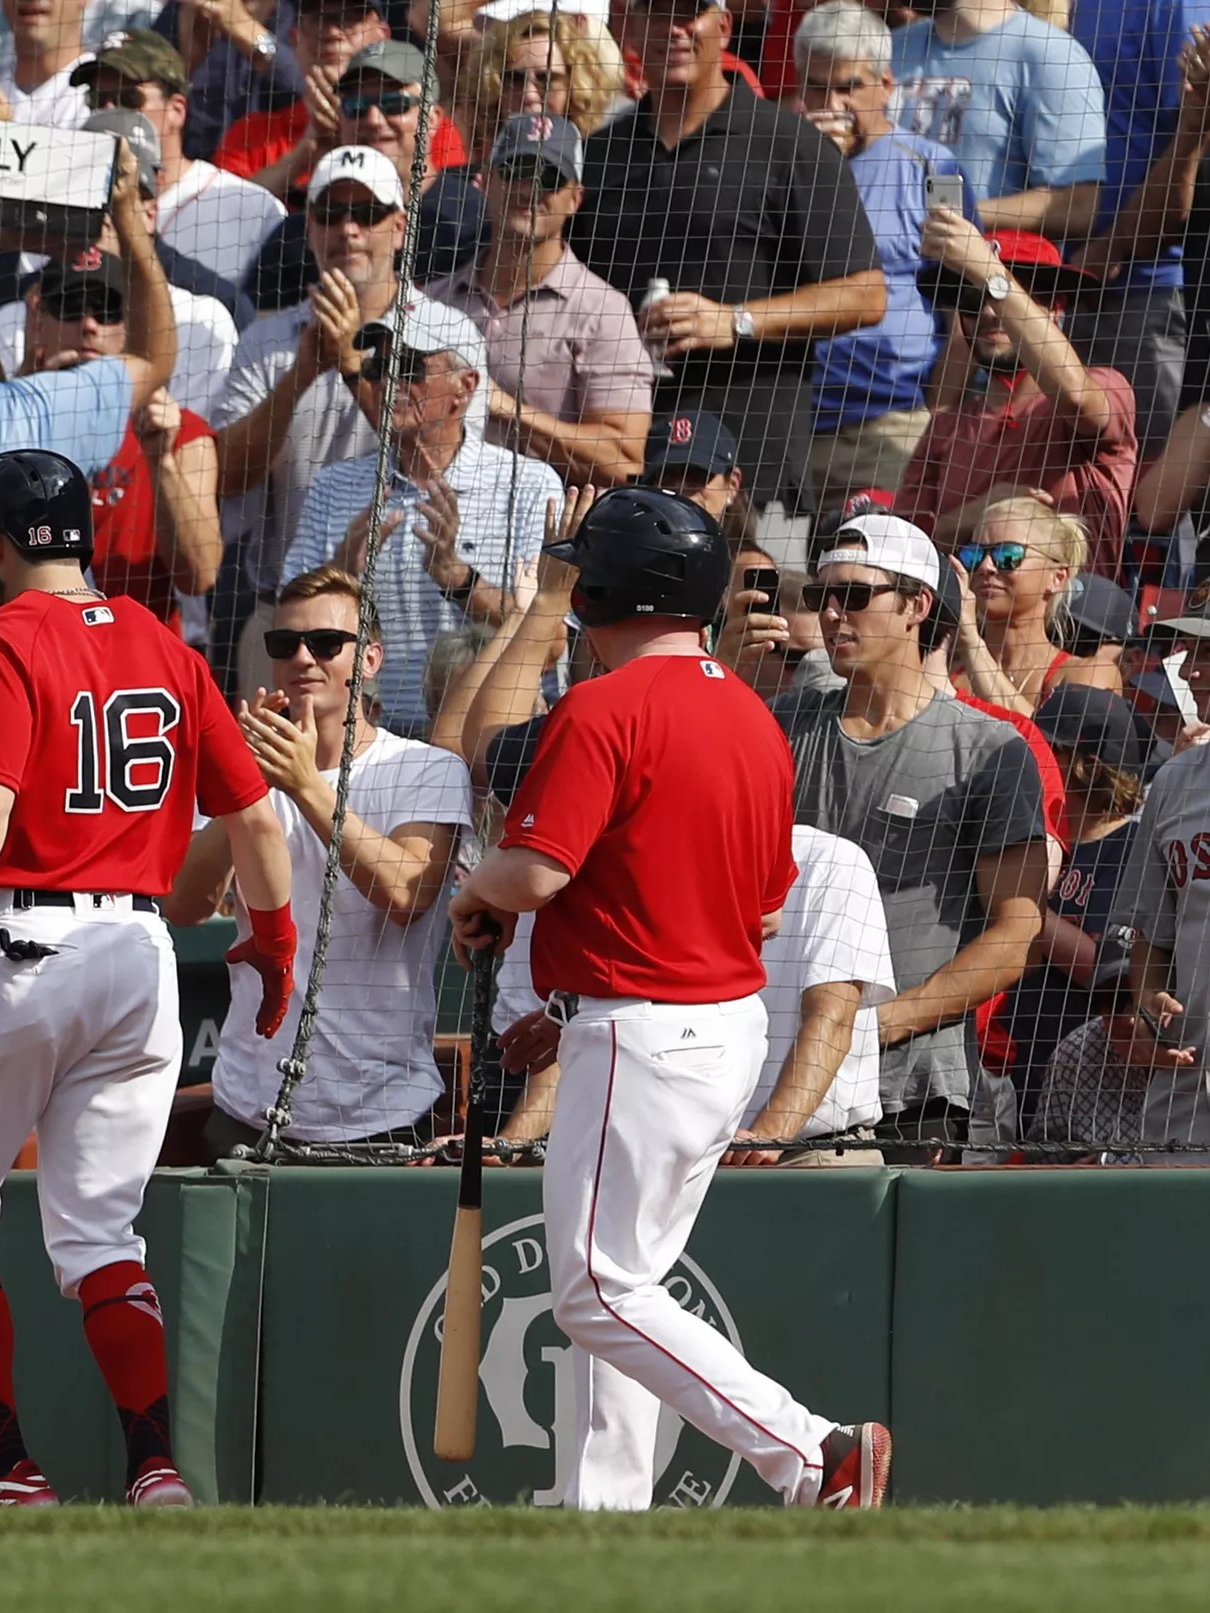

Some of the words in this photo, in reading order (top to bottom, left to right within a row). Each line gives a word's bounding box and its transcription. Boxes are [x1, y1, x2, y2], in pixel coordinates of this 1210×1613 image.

[341, 151, 364, 168] M
[28, 525, 53, 546] 16
[65, 687, 181, 813] 16
